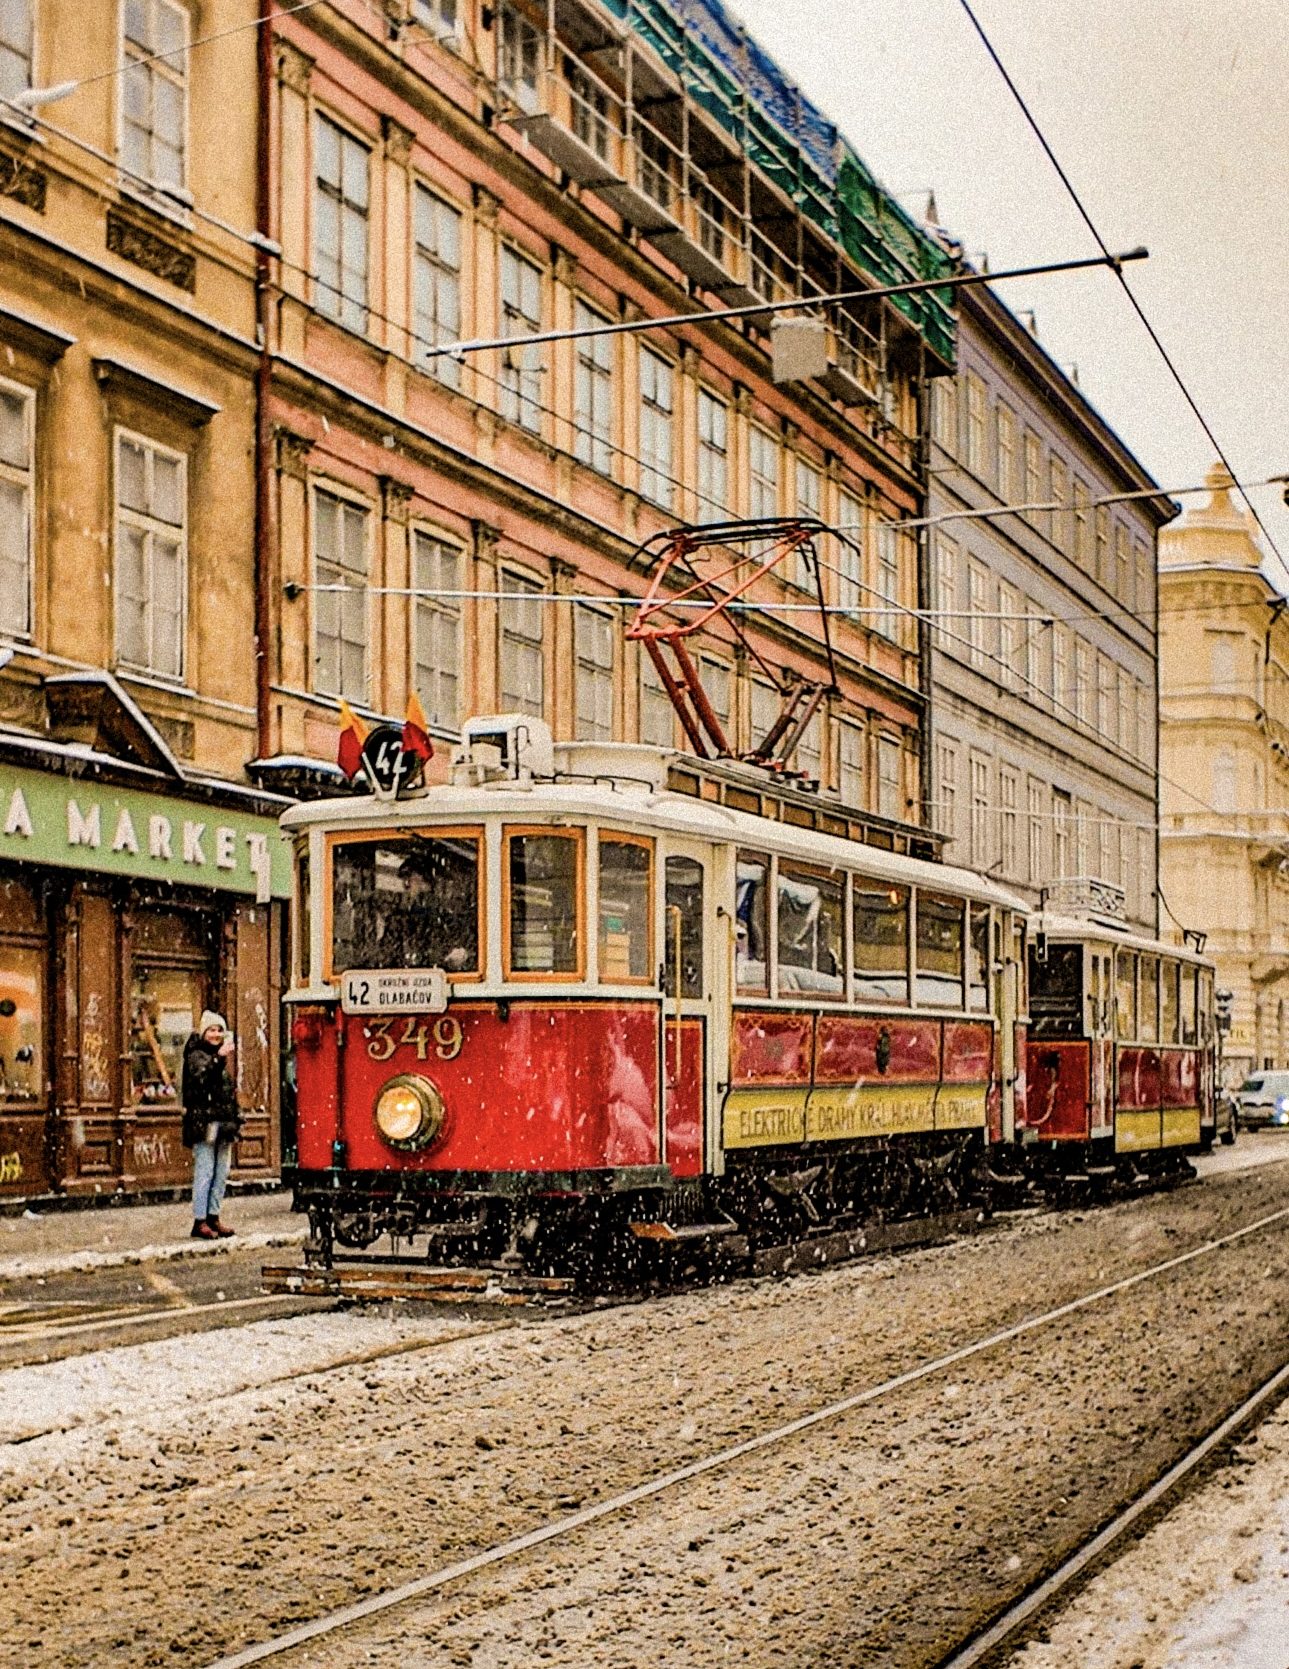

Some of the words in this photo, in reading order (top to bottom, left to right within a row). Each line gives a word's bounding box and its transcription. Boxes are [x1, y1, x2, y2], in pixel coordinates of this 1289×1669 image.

[375, 741, 408, 775] 42
[67, 799, 267, 874] MARKET
[349, 981, 370, 1005] 42
[368, 1017, 463, 1060] 349
